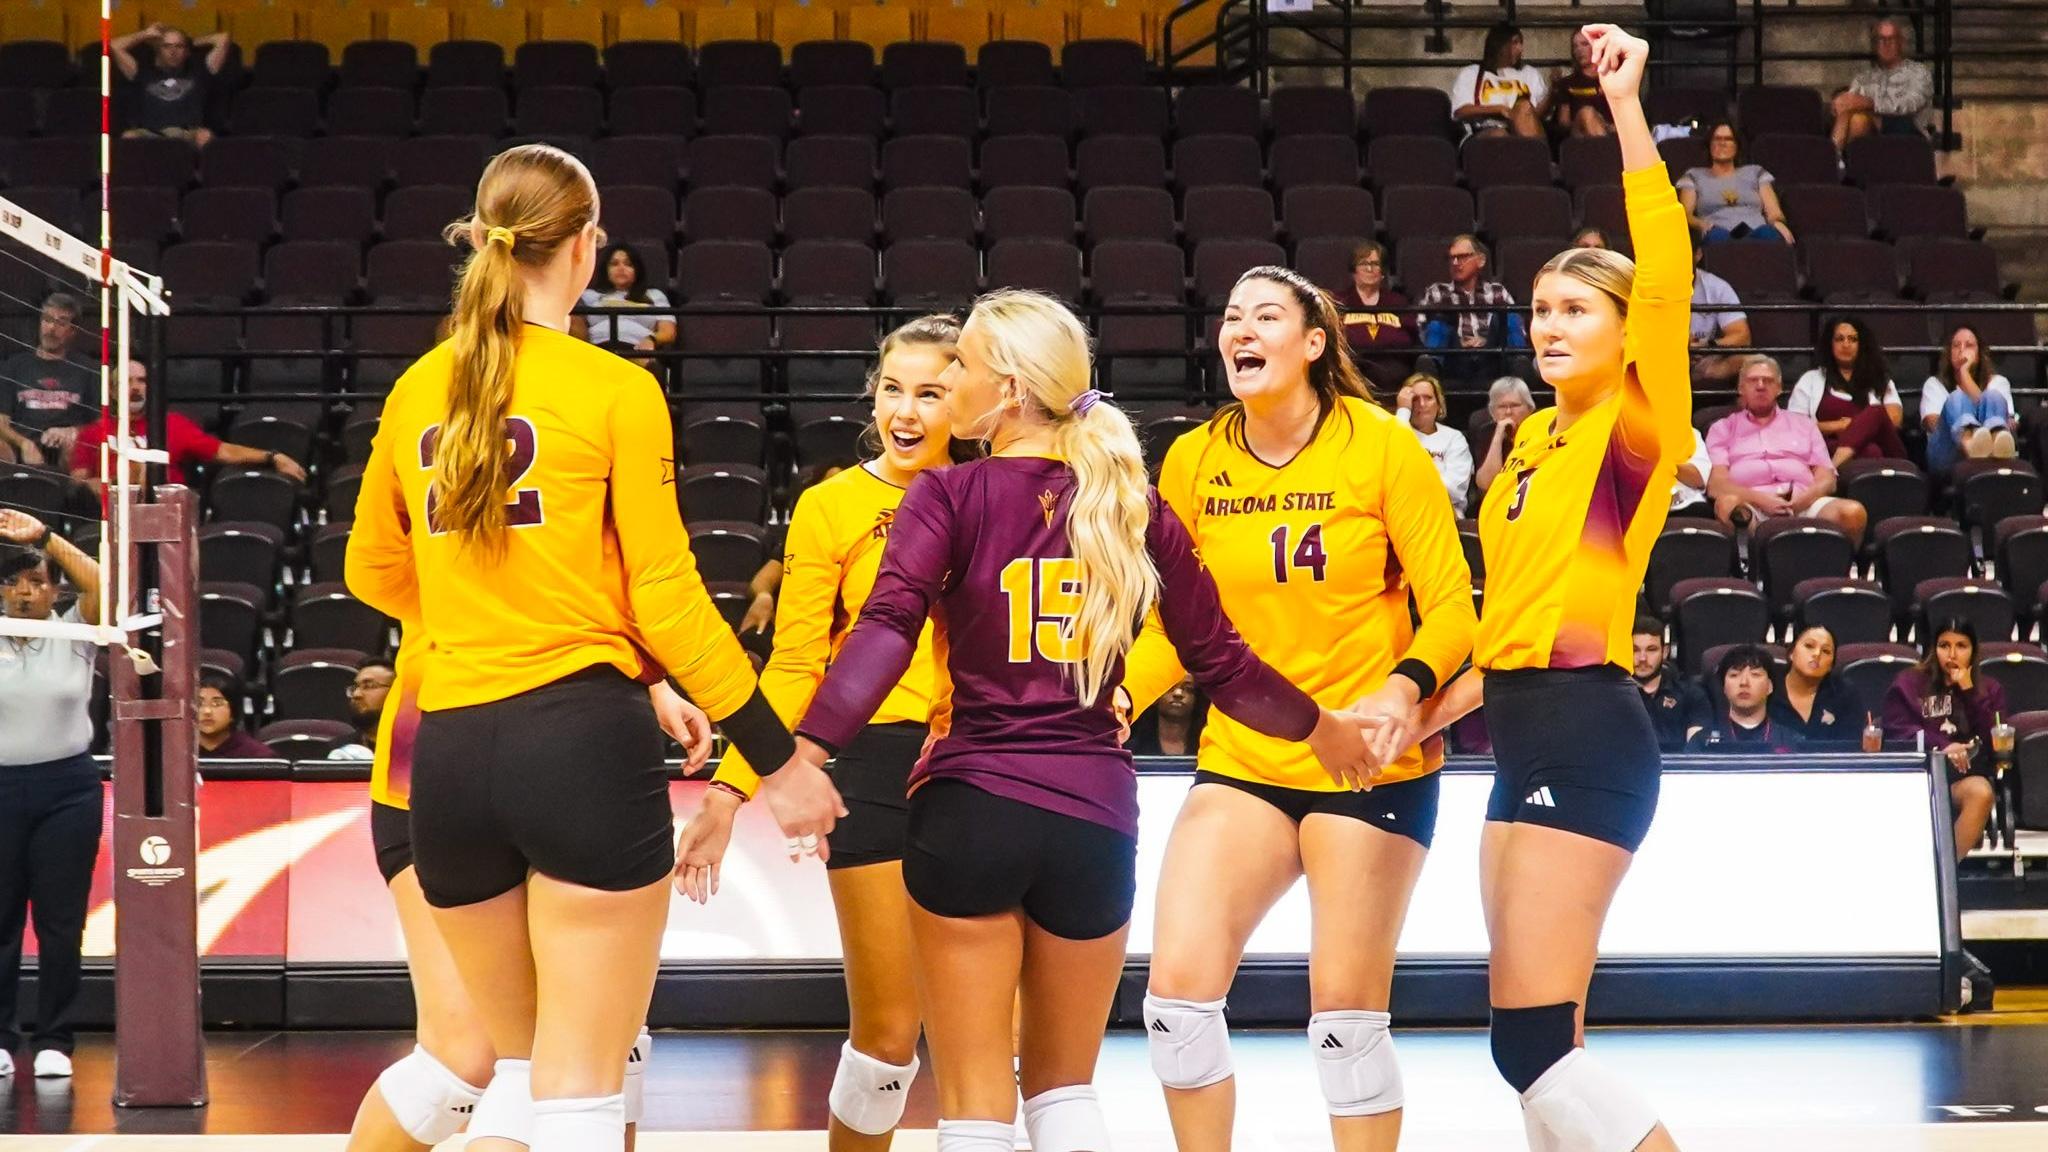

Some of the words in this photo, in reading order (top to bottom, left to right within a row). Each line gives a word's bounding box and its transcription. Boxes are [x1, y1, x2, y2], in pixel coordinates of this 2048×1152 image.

[1205, 496, 1277, 516] ARIZONA
[1282, 491, 1336, 511] STATE
[1505, 466, 1539, 523] 3
[1270, 524, 1328, 584] 14
[1000, 557, 1090, 663] 15
